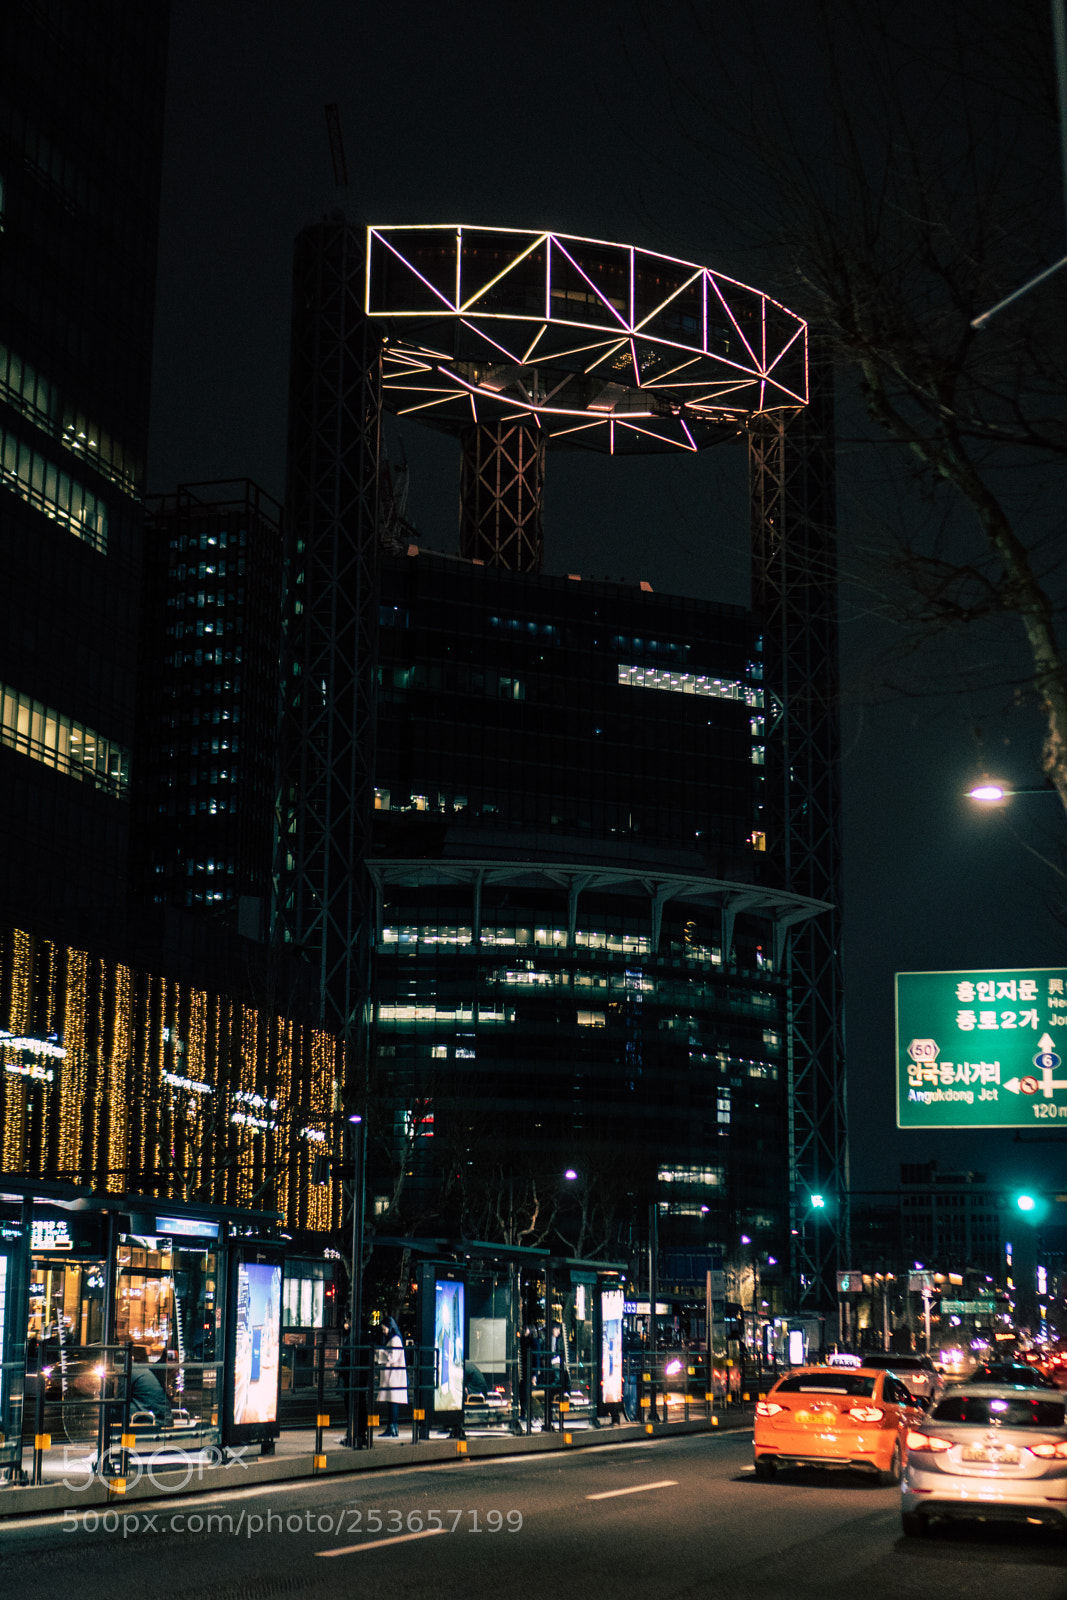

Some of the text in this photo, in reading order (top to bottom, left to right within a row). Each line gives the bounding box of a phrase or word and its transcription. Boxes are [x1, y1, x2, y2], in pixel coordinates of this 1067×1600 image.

[955, 979, 1039, 1002] 흥인지문
[955, 1008, 1040, 1031] 종로2가
[915, 1045, 932, 1056] 50
[1042, 1054, 1053, 1067] 6
[906, 1061, 1001, 1087] 안국동사거리
[908, 1088, 999, 1105] Angukdong Jct
